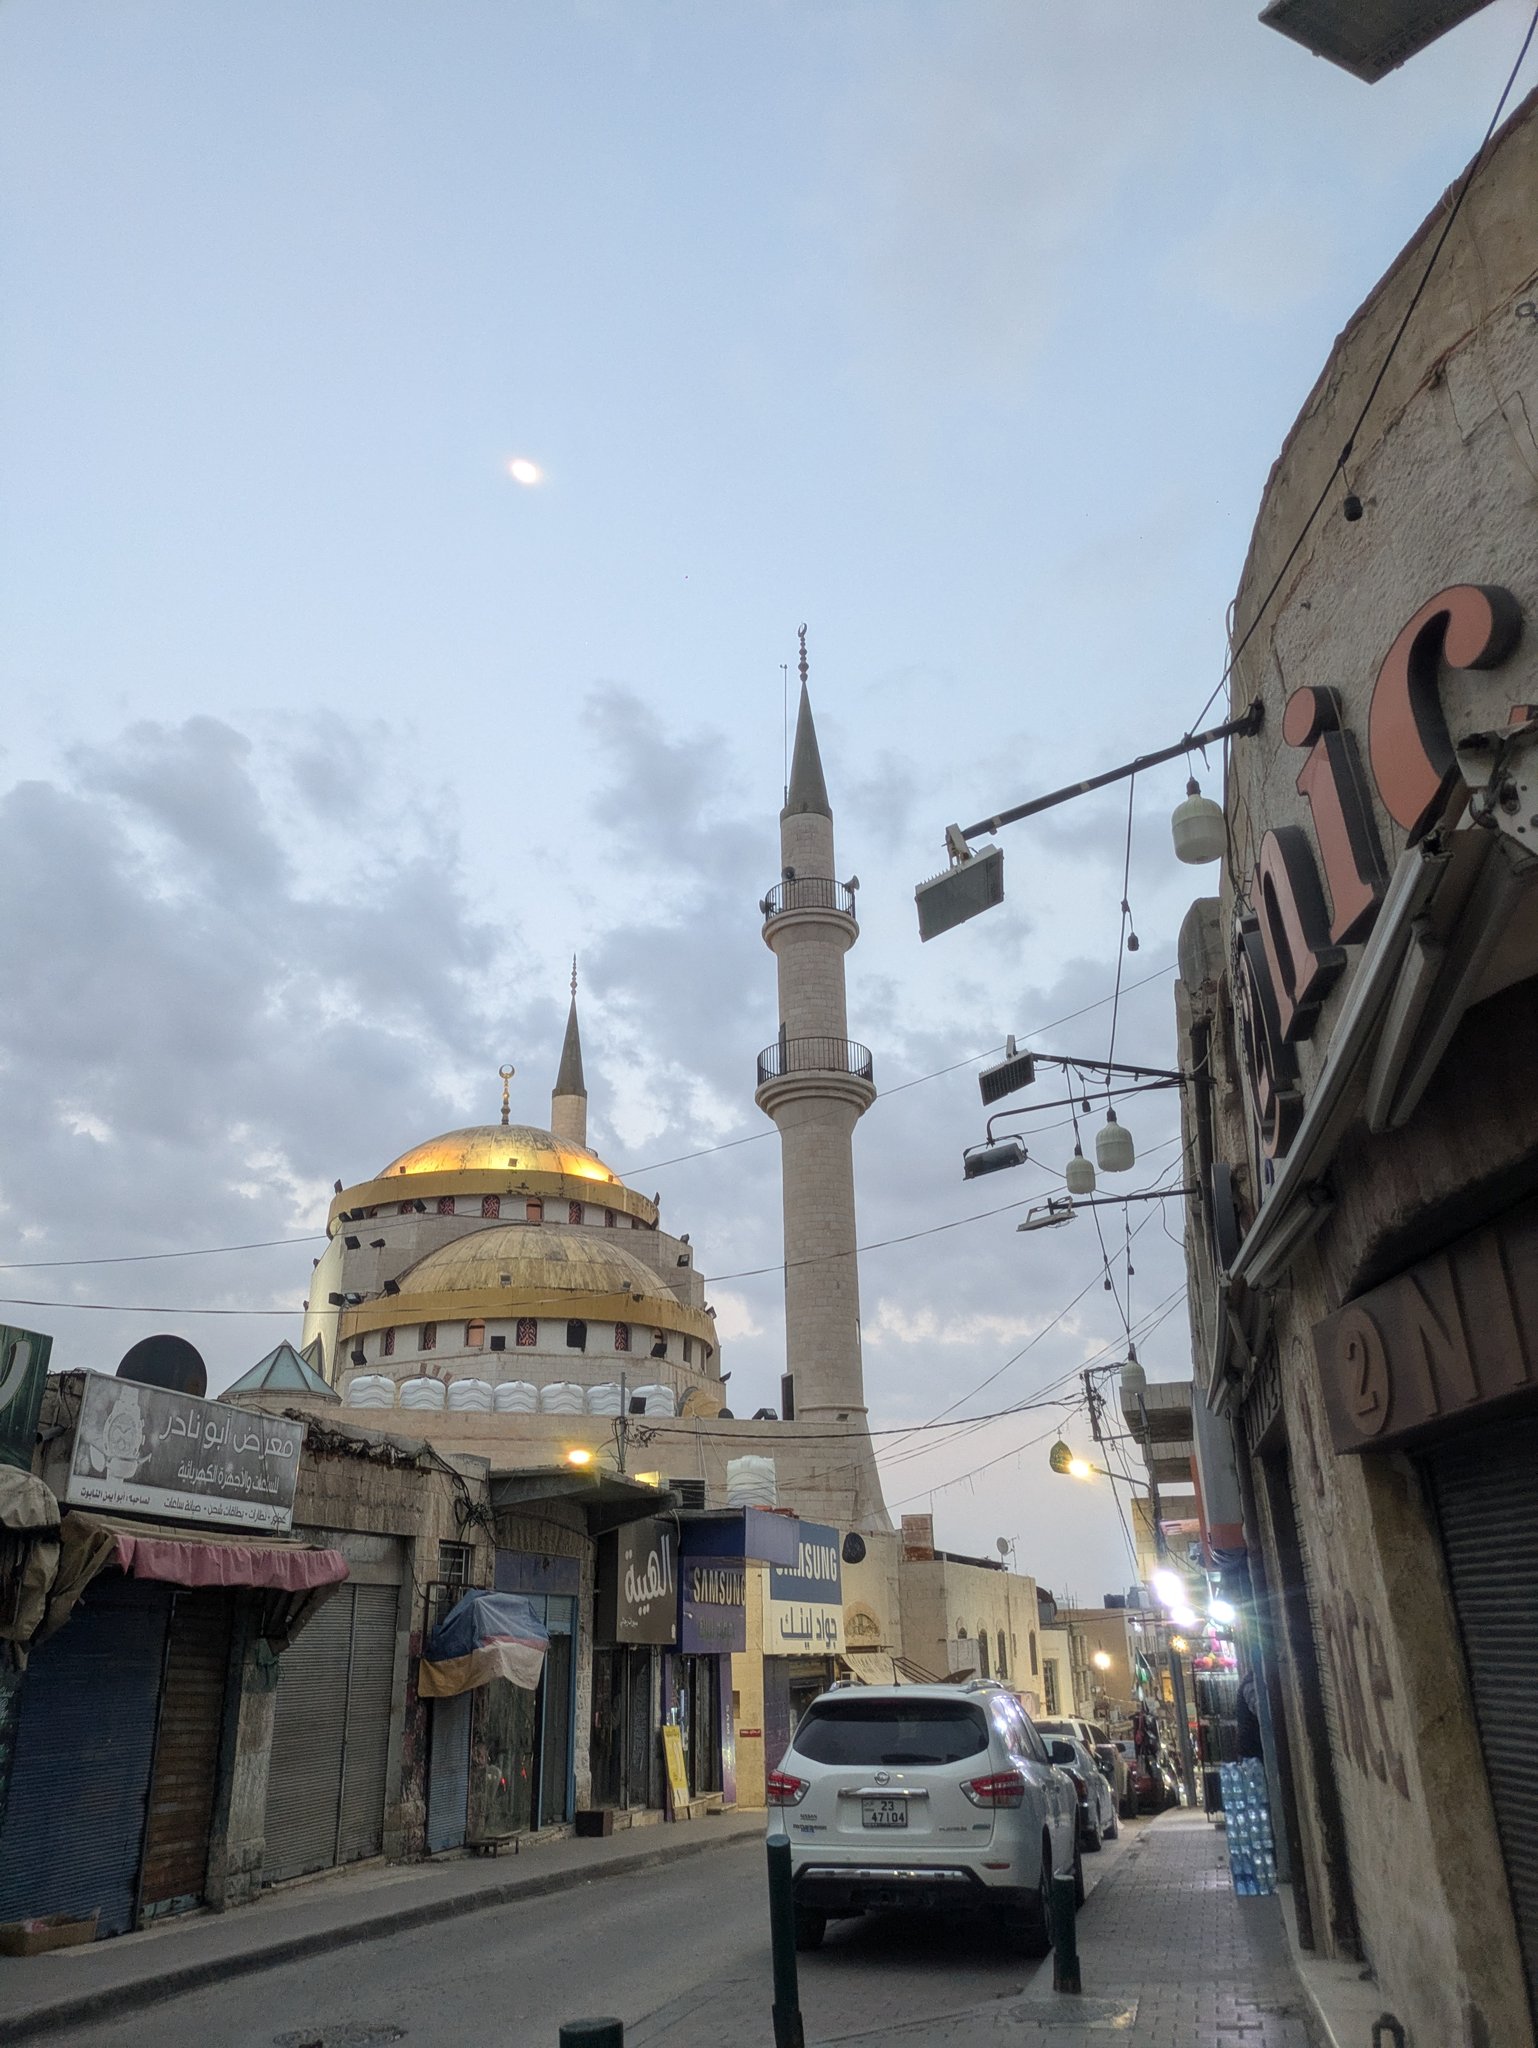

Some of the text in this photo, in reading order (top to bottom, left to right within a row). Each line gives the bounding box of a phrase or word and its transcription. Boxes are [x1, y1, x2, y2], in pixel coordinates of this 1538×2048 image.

[159, 1409, 294, 1460] معرض أبو نادر
[177, 1459, 218, 1485] الكهربائية
[625, 1533, 673, 1617] الهيبة
[780, 1606, 813, 1651] لينك
[816, 1608, 838, 1650] جواد
[871, 1812, 905, 1823] 47104
[880, 1800, 895, 1812] 23
